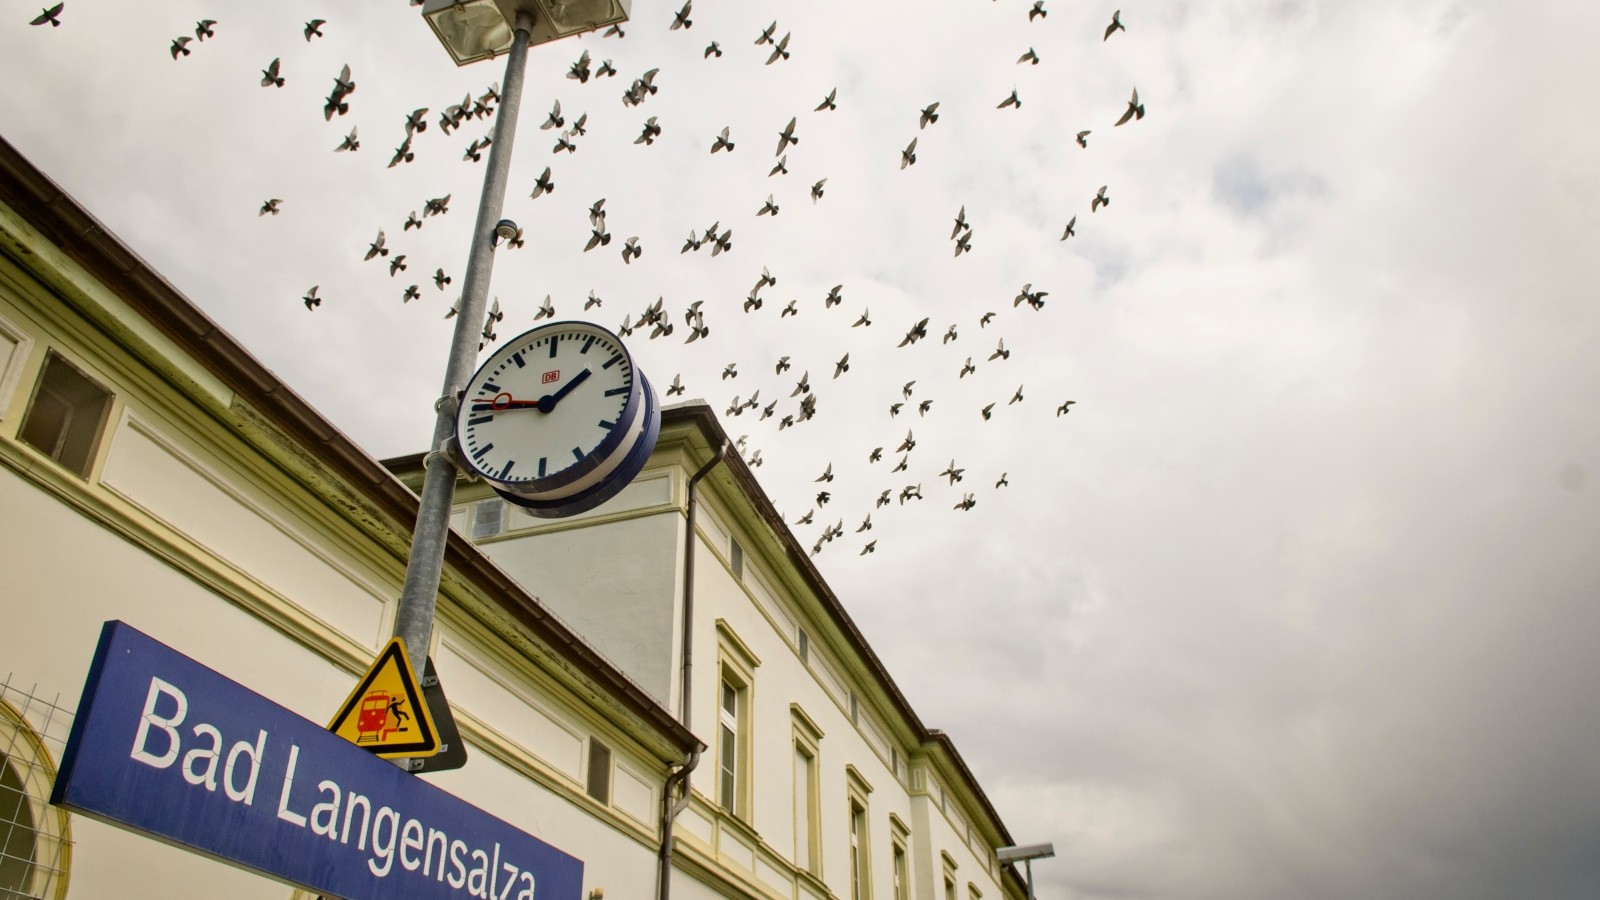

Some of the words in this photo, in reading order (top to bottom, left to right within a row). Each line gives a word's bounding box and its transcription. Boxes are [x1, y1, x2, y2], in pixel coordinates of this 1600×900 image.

[544, 372, 557, 382] DB
[131, 676, 267, 805] Bad
[277, 745, 536, 900] Langensalza
